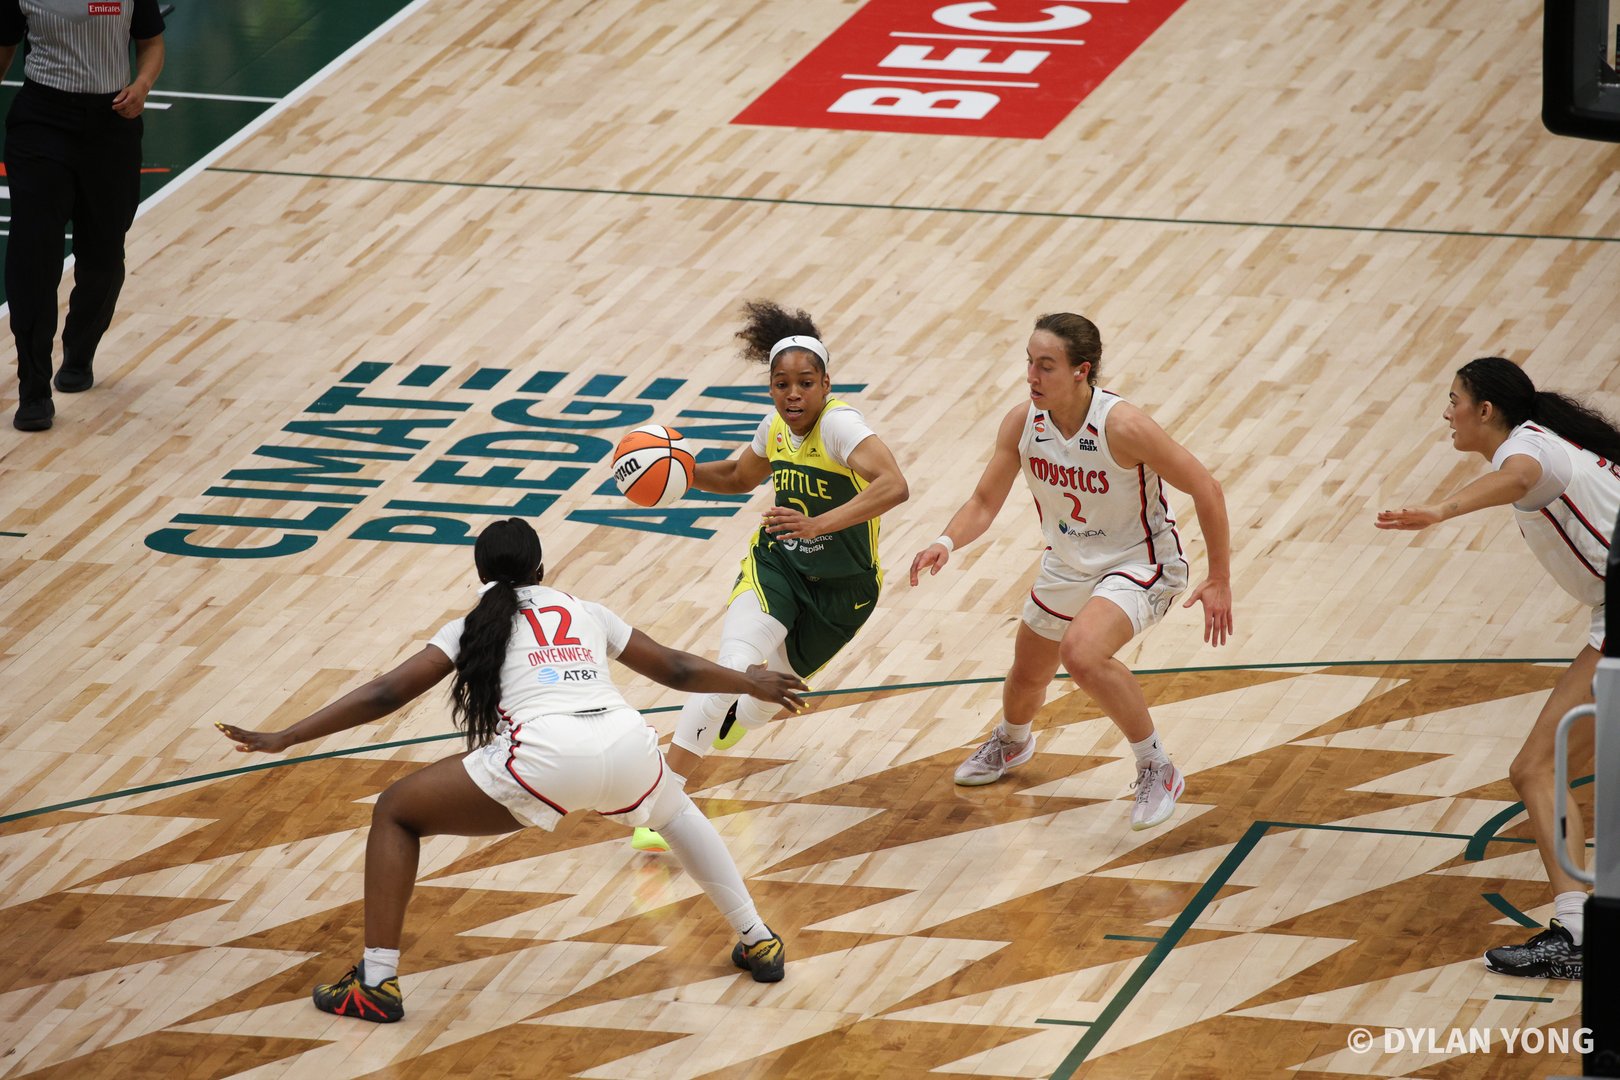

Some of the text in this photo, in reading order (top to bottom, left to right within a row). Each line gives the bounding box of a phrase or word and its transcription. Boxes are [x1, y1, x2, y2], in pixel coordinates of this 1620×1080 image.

[89, 5, 121, 13] Emirates
[1079, 438, 1095, 446] CAR
[144, 361, 512, 559] CLIMATE
[347, 371, 688, 546] PLEDGE
[565, 384, 868, 540] ANA
[773, 468, 832, 500] EATTLE
[1063, 492, 1087, 524] 2
[520, 605, 582, 647] 12
[563, 669, 598, 681] AT&T
